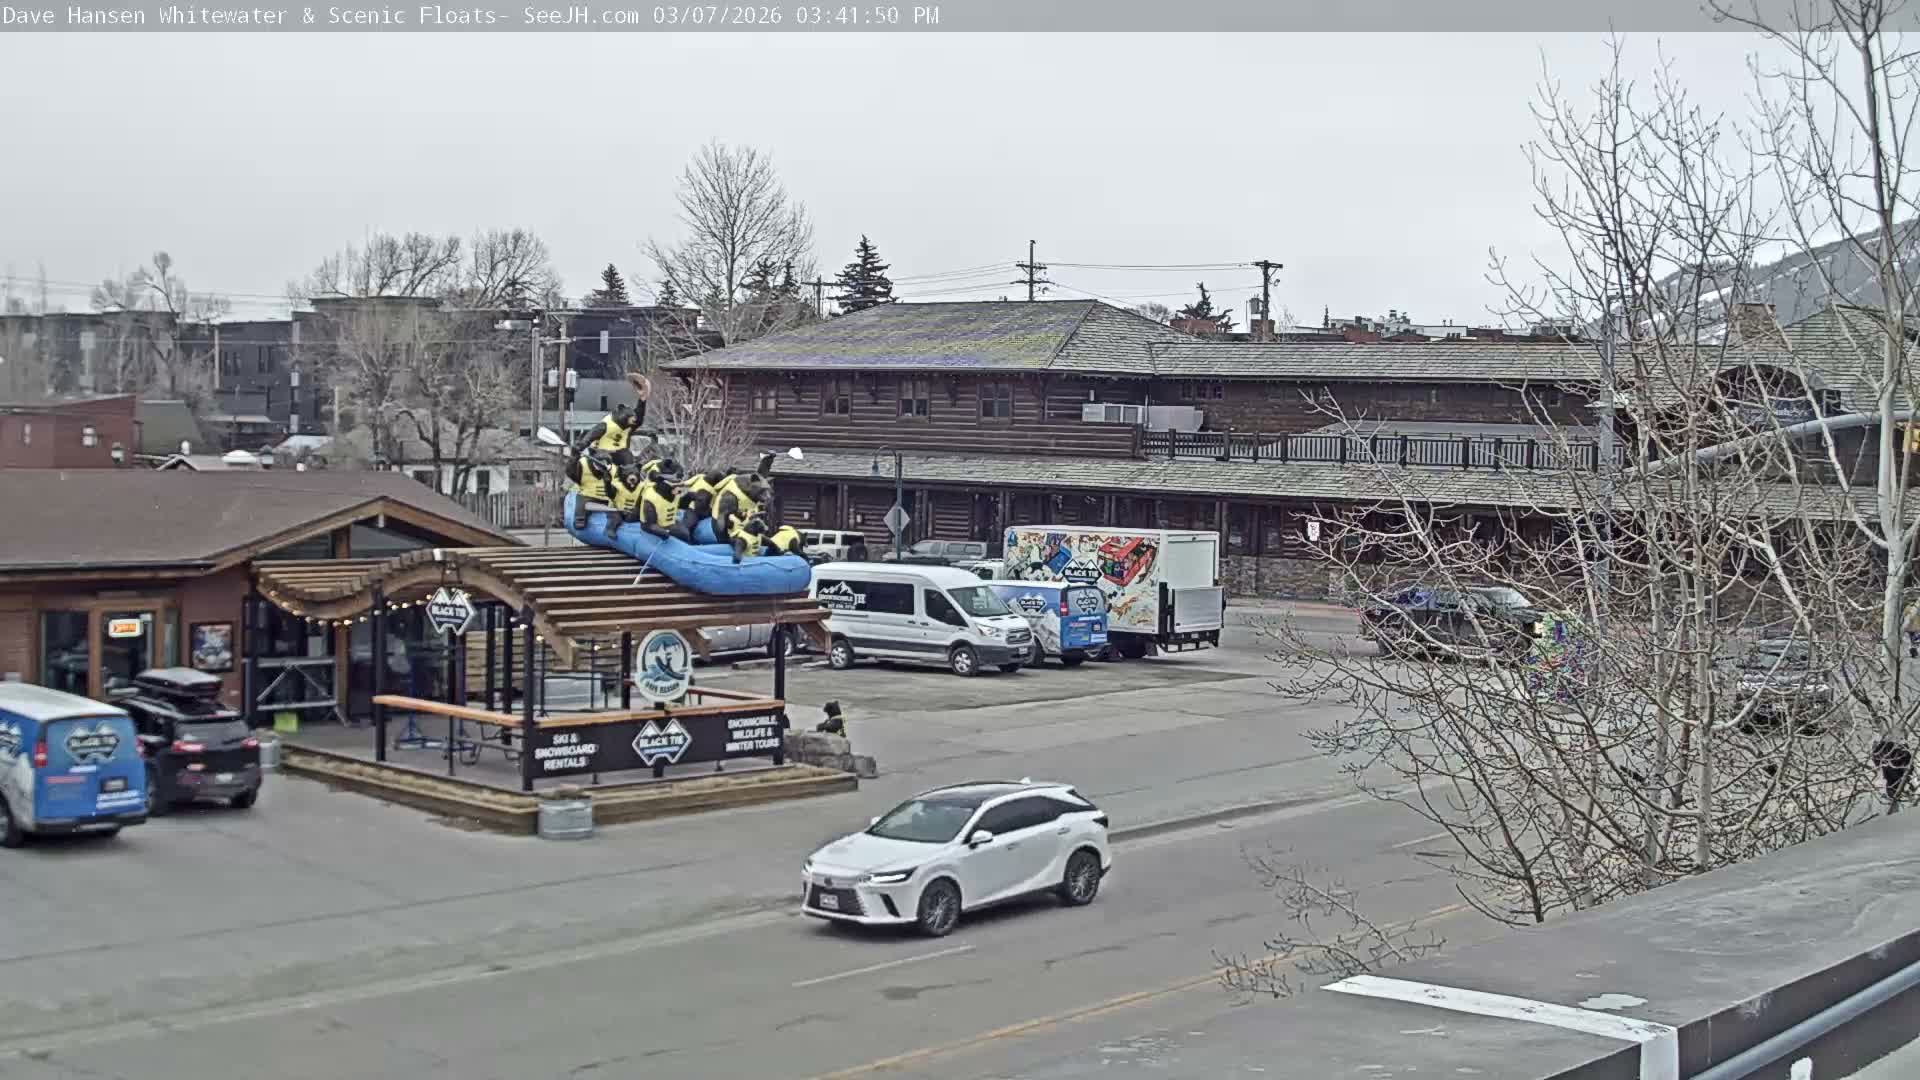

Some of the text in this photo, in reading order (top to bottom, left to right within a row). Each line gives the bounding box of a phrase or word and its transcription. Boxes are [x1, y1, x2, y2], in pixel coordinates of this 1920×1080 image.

[1064, 568, 1099, 577] BLACK TIE
[552, 734, 569, 745] SKI
[732, 727, 766, 740] WILDLIFE
[640, 735, 684, 749] BLACK TIE
[725, 738, 780, 752] WINTER TOURS
[534, 743, 599, 760] SNOWBOARD
[543, 756, 588, 770] RENTALS
